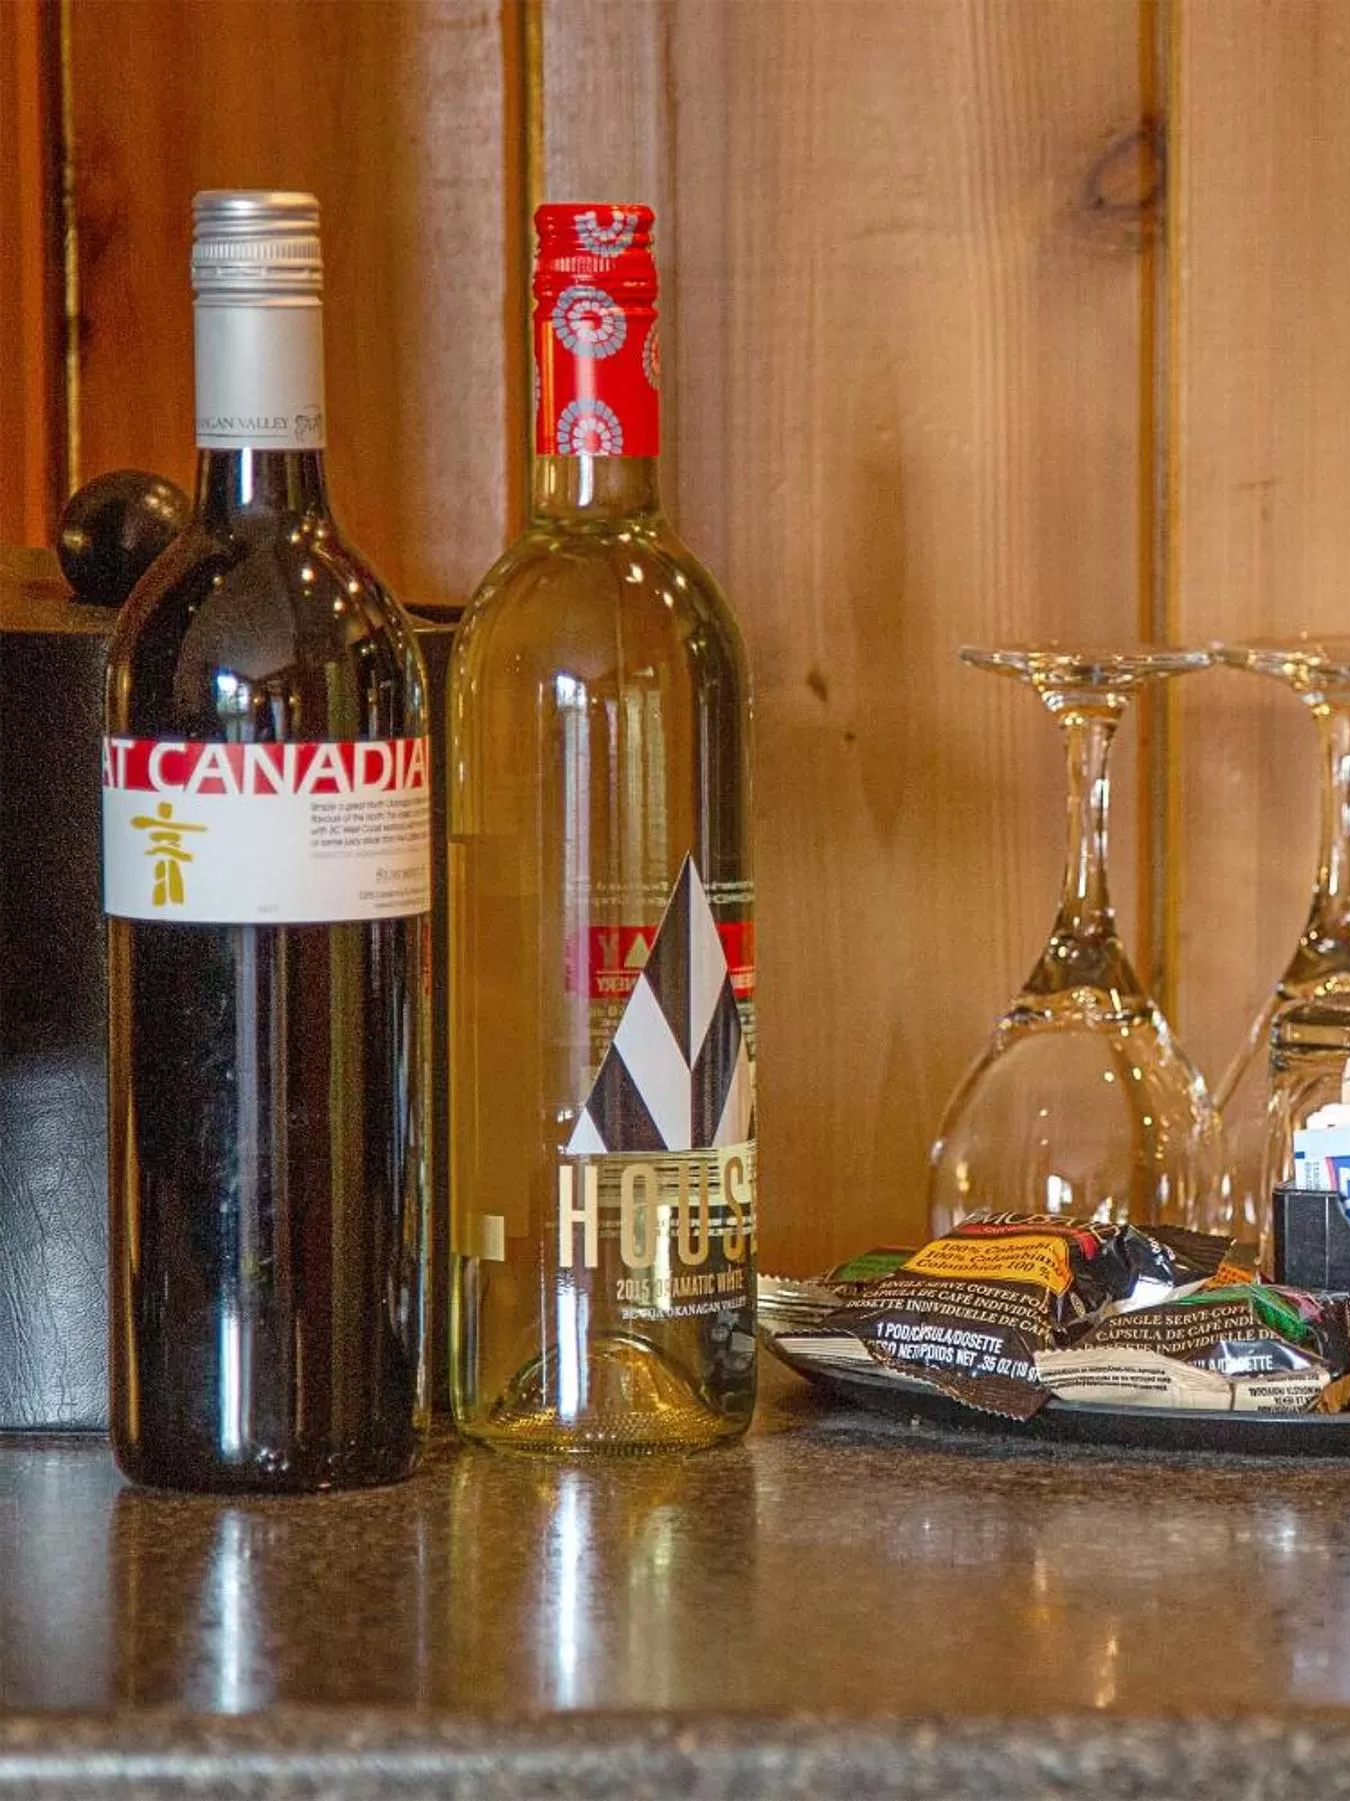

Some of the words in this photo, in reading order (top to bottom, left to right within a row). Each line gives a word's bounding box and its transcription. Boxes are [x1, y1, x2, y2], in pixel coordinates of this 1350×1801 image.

[237, 416, 288, 429] VALLEY
[149, 737, 429, 796] CANADIA
[559, 1156, 756, 1269] HOUS
[617, 1279, 650, 1300] 2015
[918, 1288, 935, 1298] DE
[938, 1291, 974, 1305] CAFÉ
[926, 1281, 966, 1290] SERVE
[968, 1284, 1019, 1301] COFFEE
[667, 1302, 721, 1318] OKANAGAN
[906, 1300, 998, 1324] INDIVIDUELLE
[1000, 1315, 1017, 1327] DE
[1109, 1312, 1162, 1327] SINGLE
[1165, 1309, 1208, 1326] SERVE
[877, 1322, 884, 1338] 1
[1166, 1329, 1186, 1340] DE
[1157, 1329, 1255, 1355] INDIVIDUELLE
[956, 1348, 978, 1367] NET
[996, 1358, 1011, 1375] OZ
